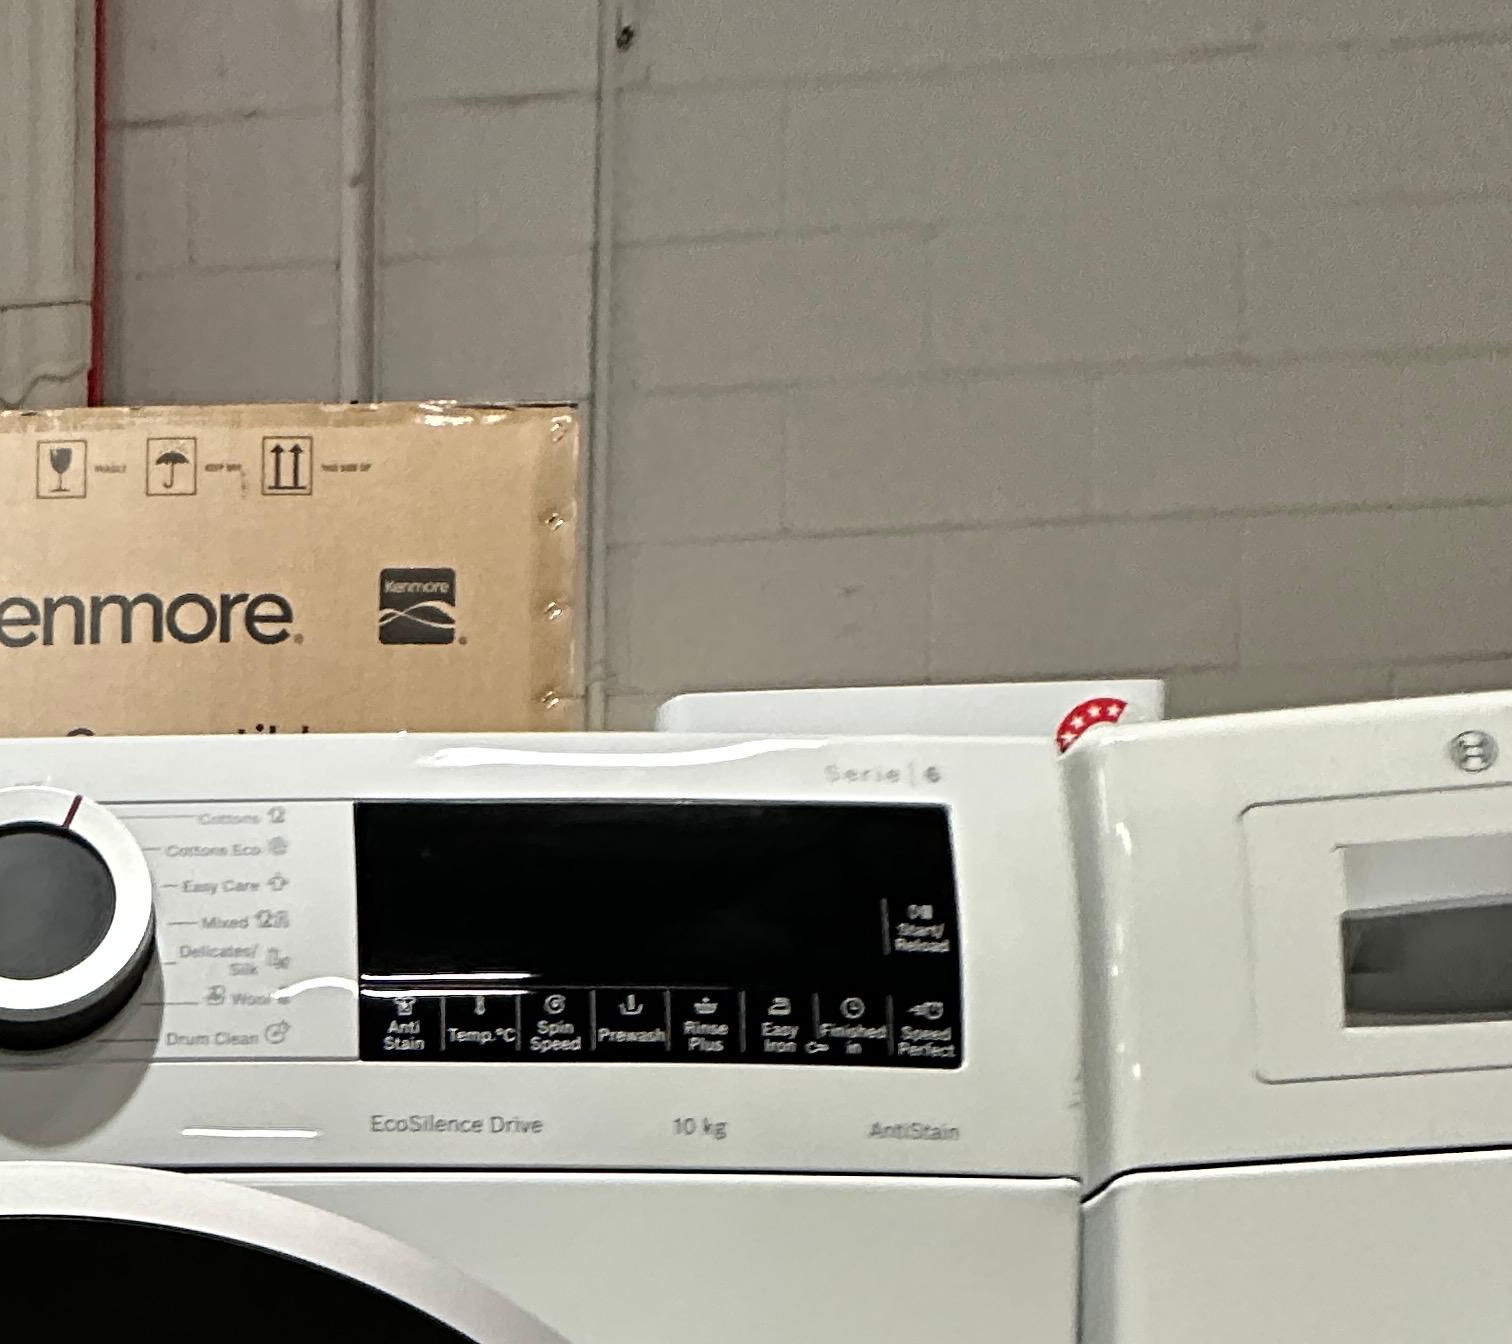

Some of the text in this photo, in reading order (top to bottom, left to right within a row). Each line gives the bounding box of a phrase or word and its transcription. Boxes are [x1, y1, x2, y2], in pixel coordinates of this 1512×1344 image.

[166, 844, 261, 857] Cottons Eco
[182, 880, 260, 894] Easy Care
[202, 917, 249, 929] Mixed
[388, 1020, 420, 1034] Anti
[537, 1020, 574, 1035] Spin
[167, 1032, 259, 1045] Drum Clean
[383, 1036, 425, 1050] Stain
[530, 1036, 581, 1053] Speed
[688, 1037, 724, 1051] Plus
[370, 1115, 543, 1133] EcoSilence Drive
[673, 1118, 728, 1139] 10 kg
